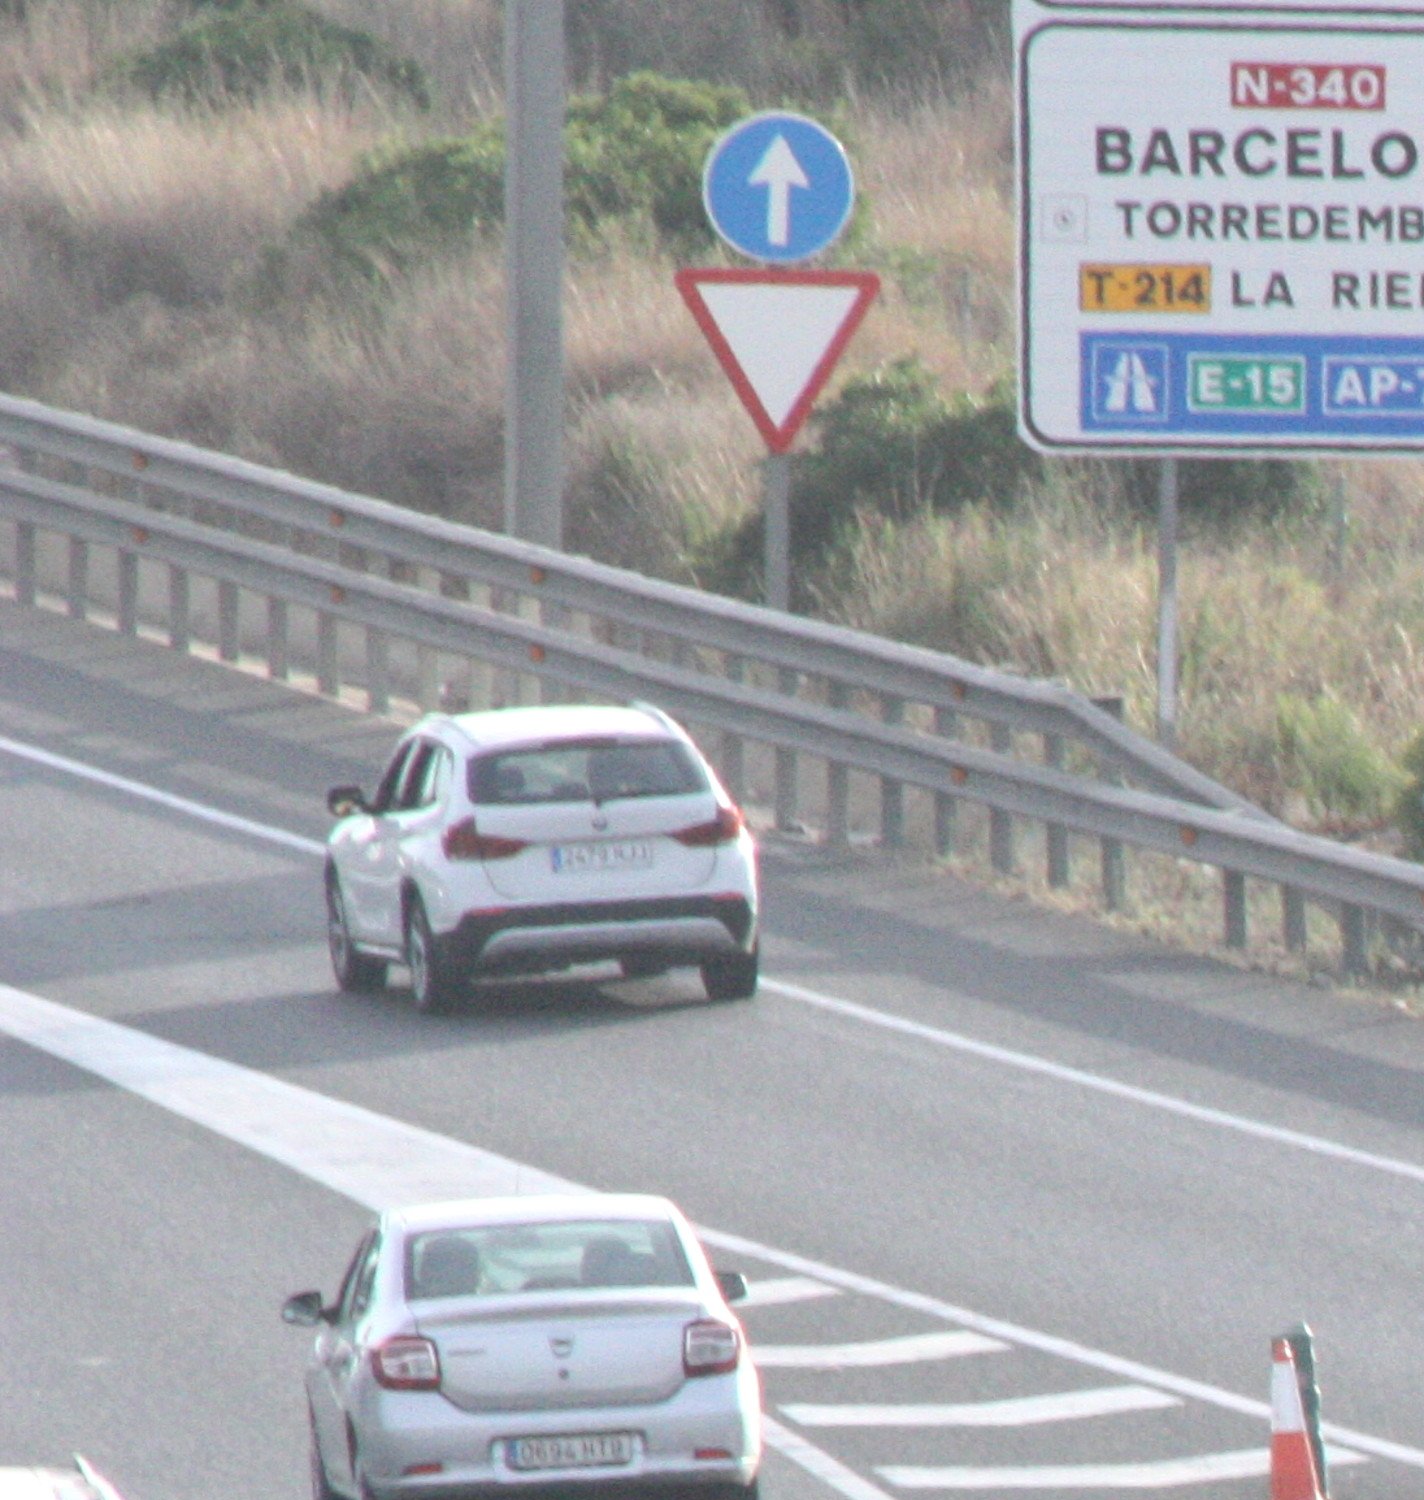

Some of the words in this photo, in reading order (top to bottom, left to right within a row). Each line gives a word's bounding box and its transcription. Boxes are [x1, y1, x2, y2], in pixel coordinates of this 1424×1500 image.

[1236, 67, 1380, 106] N-340
[1086, 269, 1207, 307] T-214
[1231, 271, 1295, 307] LA
[1200, 366, 1296, 403] E-15
